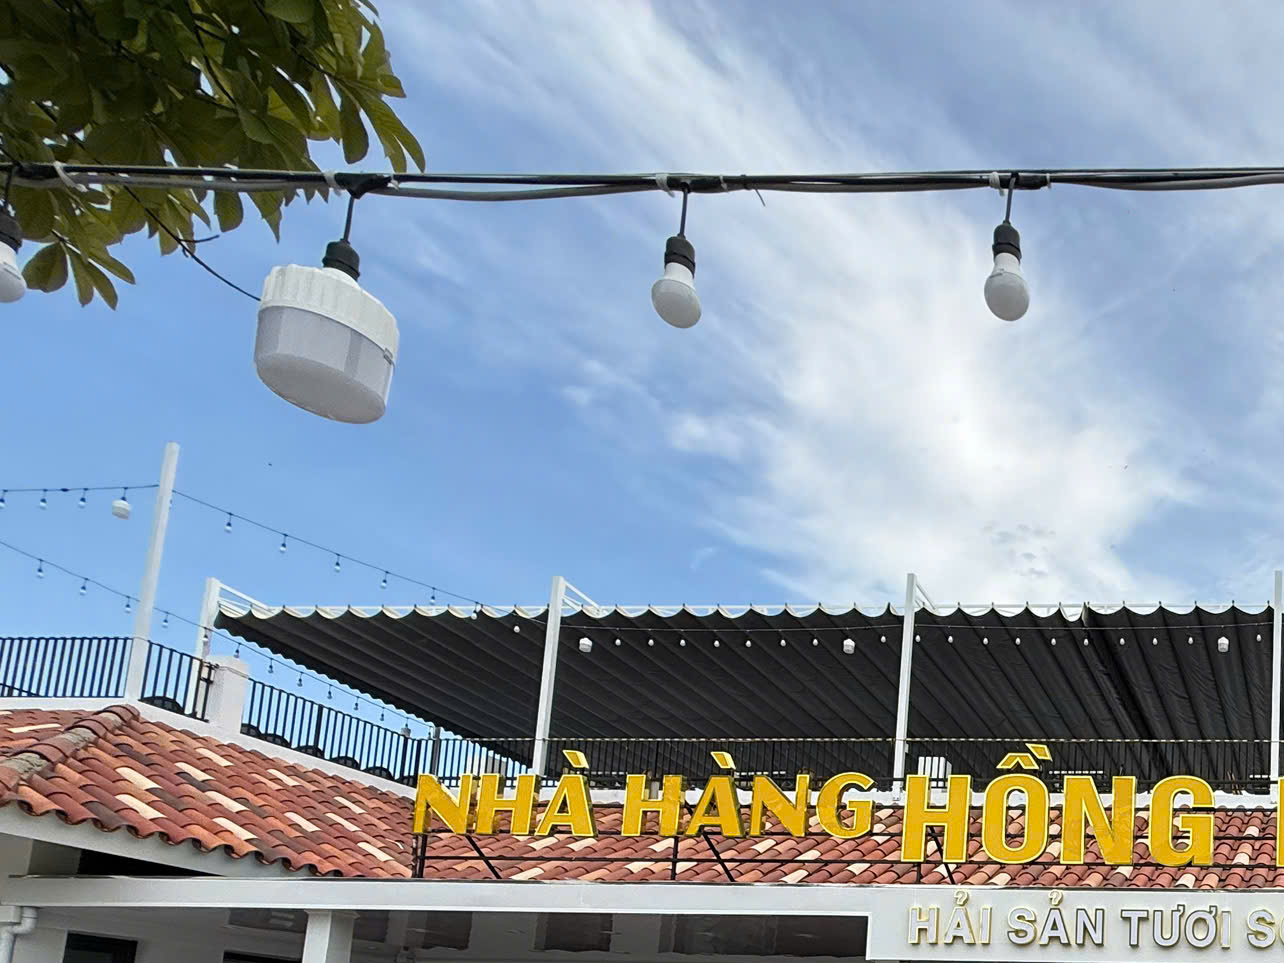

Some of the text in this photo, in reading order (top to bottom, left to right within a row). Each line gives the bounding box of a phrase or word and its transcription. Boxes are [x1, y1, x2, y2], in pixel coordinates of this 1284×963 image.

[413, 749, 596, 837] NHÀ
[621, 751, 876, 839] HÀNG
[900, 742, 1216, 867] HỒNG
[907, 889, 993, 945] HẢI
[1006, 889, 1105, 946] SẢN
[1120, 903, 1232, 949] TƯƠI
